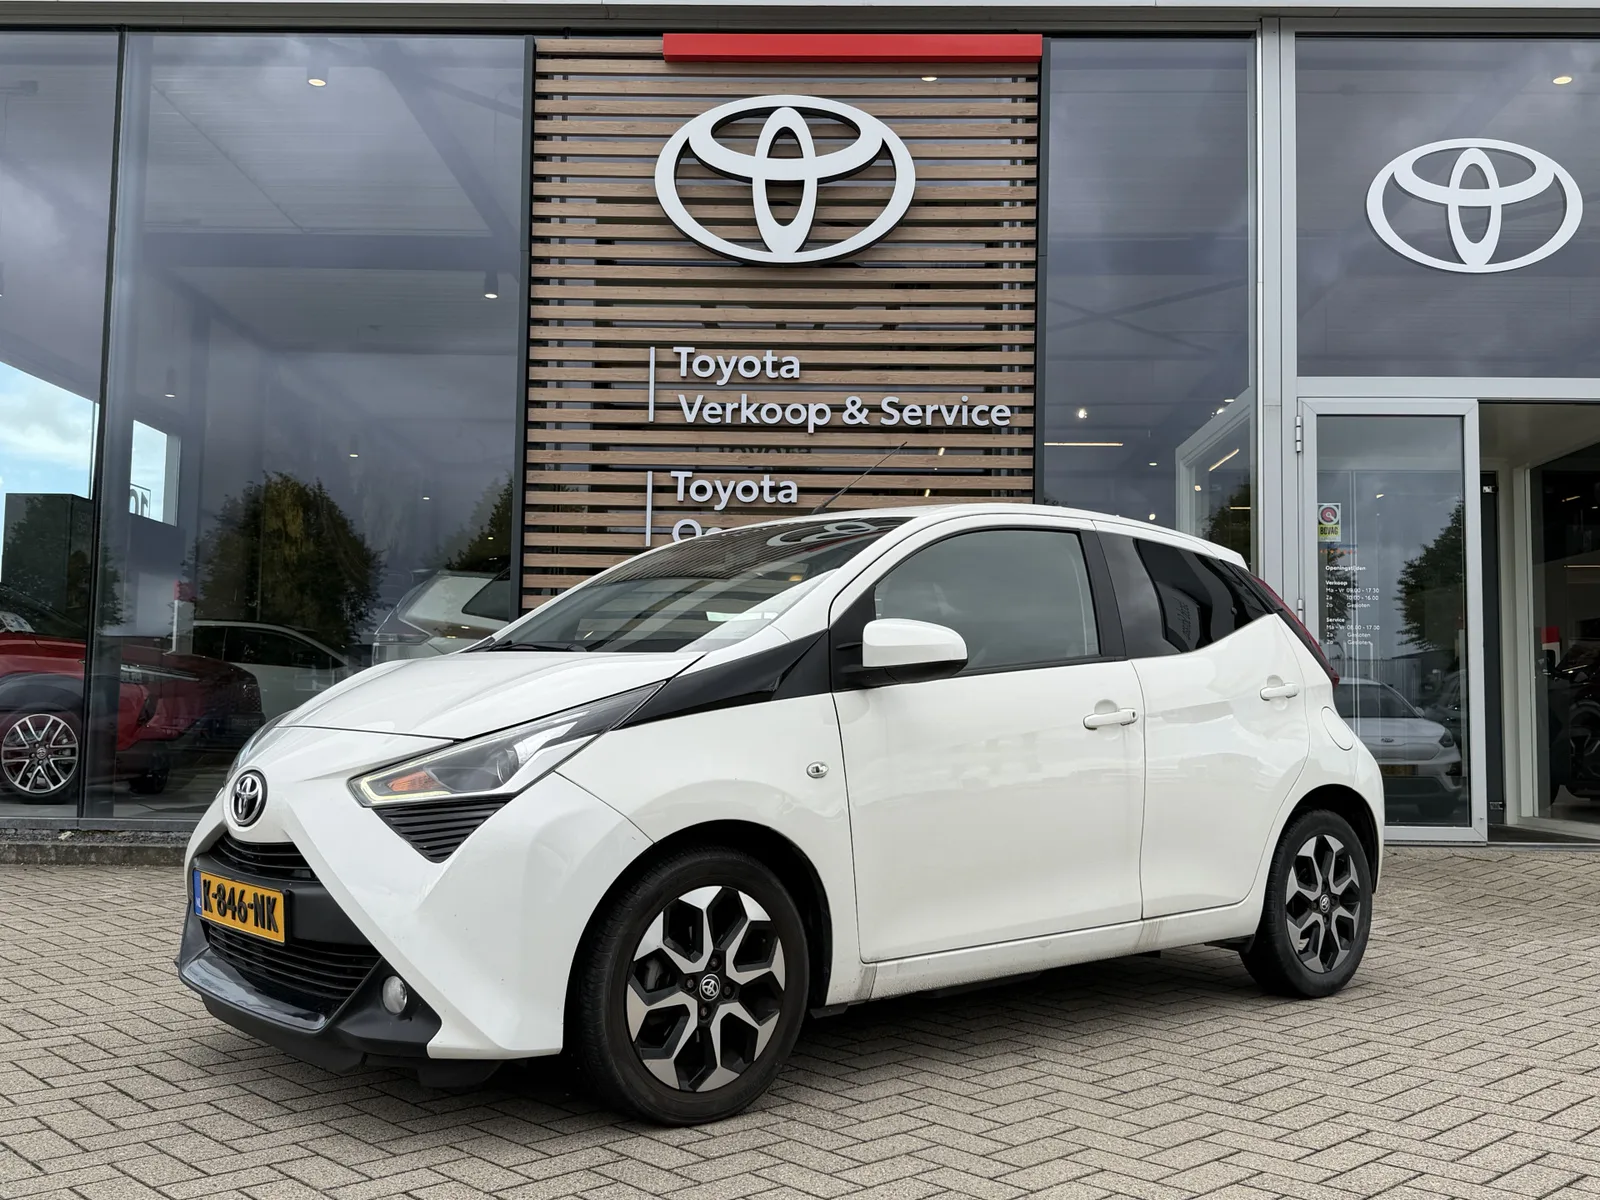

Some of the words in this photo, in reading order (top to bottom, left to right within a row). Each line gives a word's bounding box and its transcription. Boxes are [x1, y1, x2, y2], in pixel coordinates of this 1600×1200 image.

[673, 347, 800, 386] Toyota
[678, 394, 831, 433] Verkoop
[842, 395, 870, 425] &
[880, 395, 1012, 427] Service
[670, 471, 798, 511] Toyota
[1320, 526, 1338, 535] BOVAG
[203, 879, 279, 933] K-846-NK
